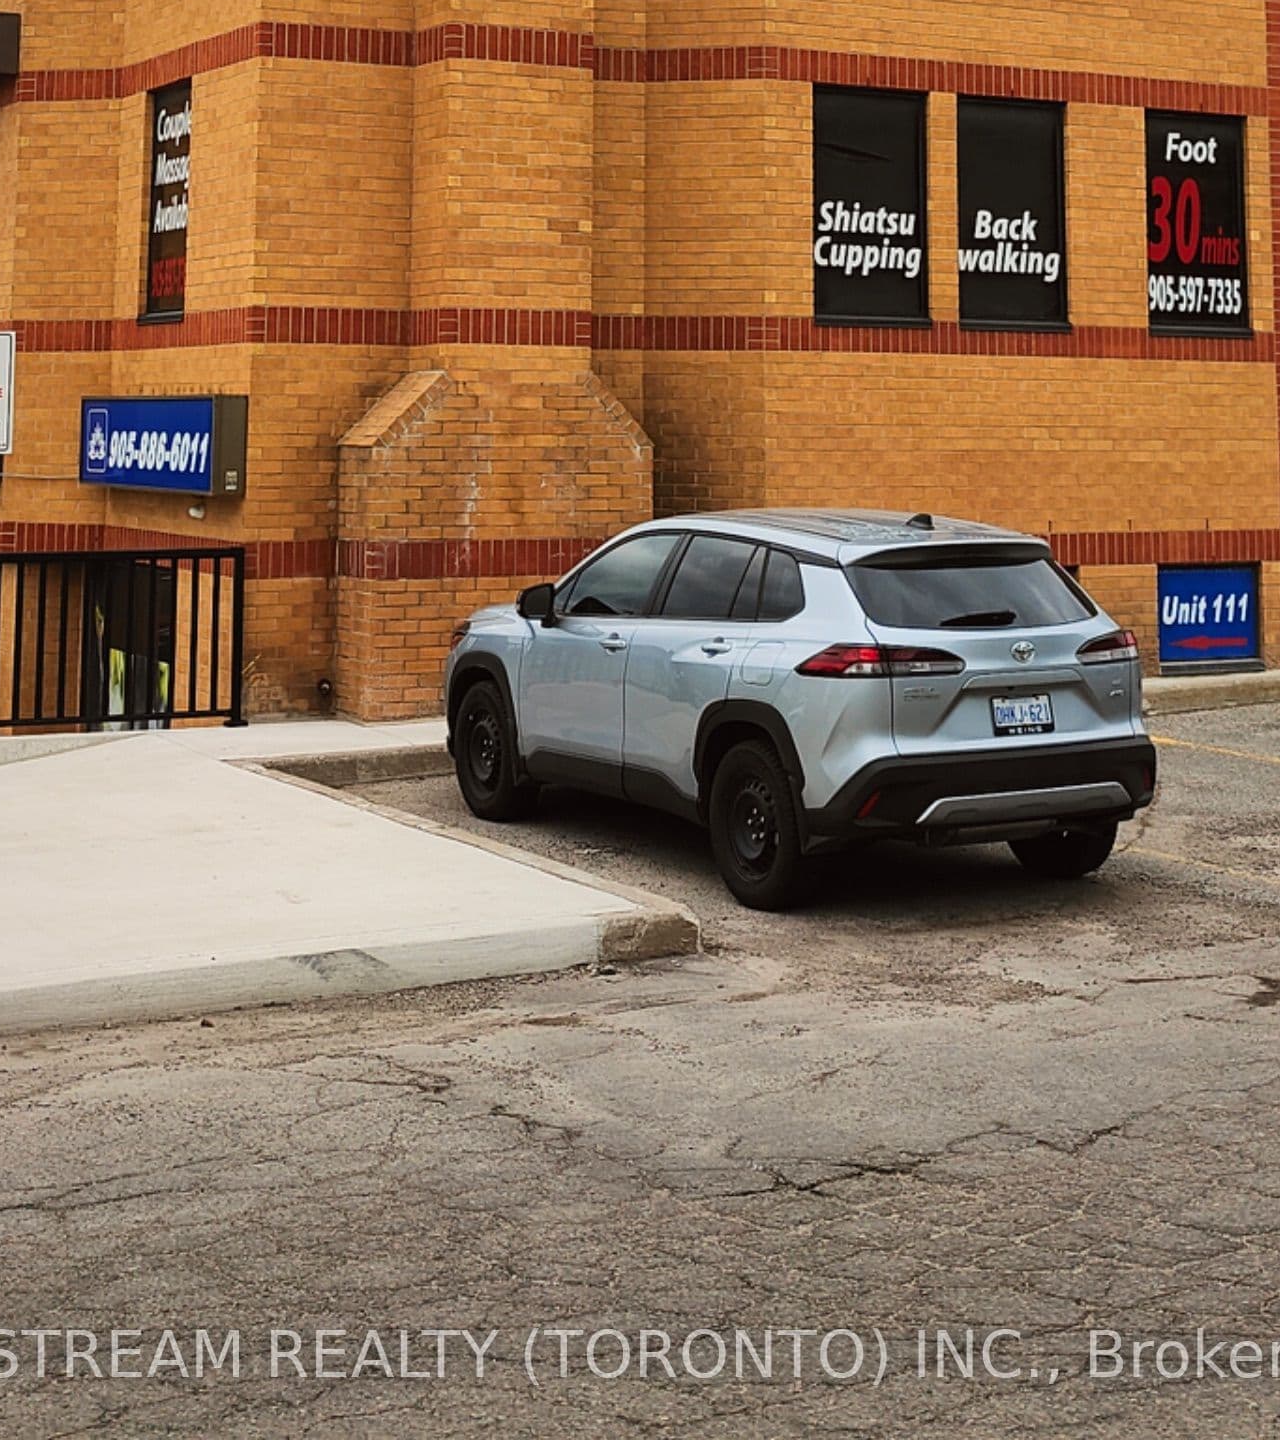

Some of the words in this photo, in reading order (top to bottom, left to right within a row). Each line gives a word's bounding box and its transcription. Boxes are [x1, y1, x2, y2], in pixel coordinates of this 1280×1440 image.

[1166, 132, 1217, 163] Foot
[818, 200, 915, 236] Shiatsu
[974, 209, 1038, 242] Back
[1148, 175, 1201, 265] 30
[1202, 226, 1240, 266] mins
[813, 236, 921, 278] Cupping
[958, 244, 1060, 283] walking
[1148, 273, 1241, 315] 905-597-7335
[108, 430, 210, 474] 905-886-6011
[1162, 594, 1207, 625] Unit
[1212, 592, 1249, 623] 111
